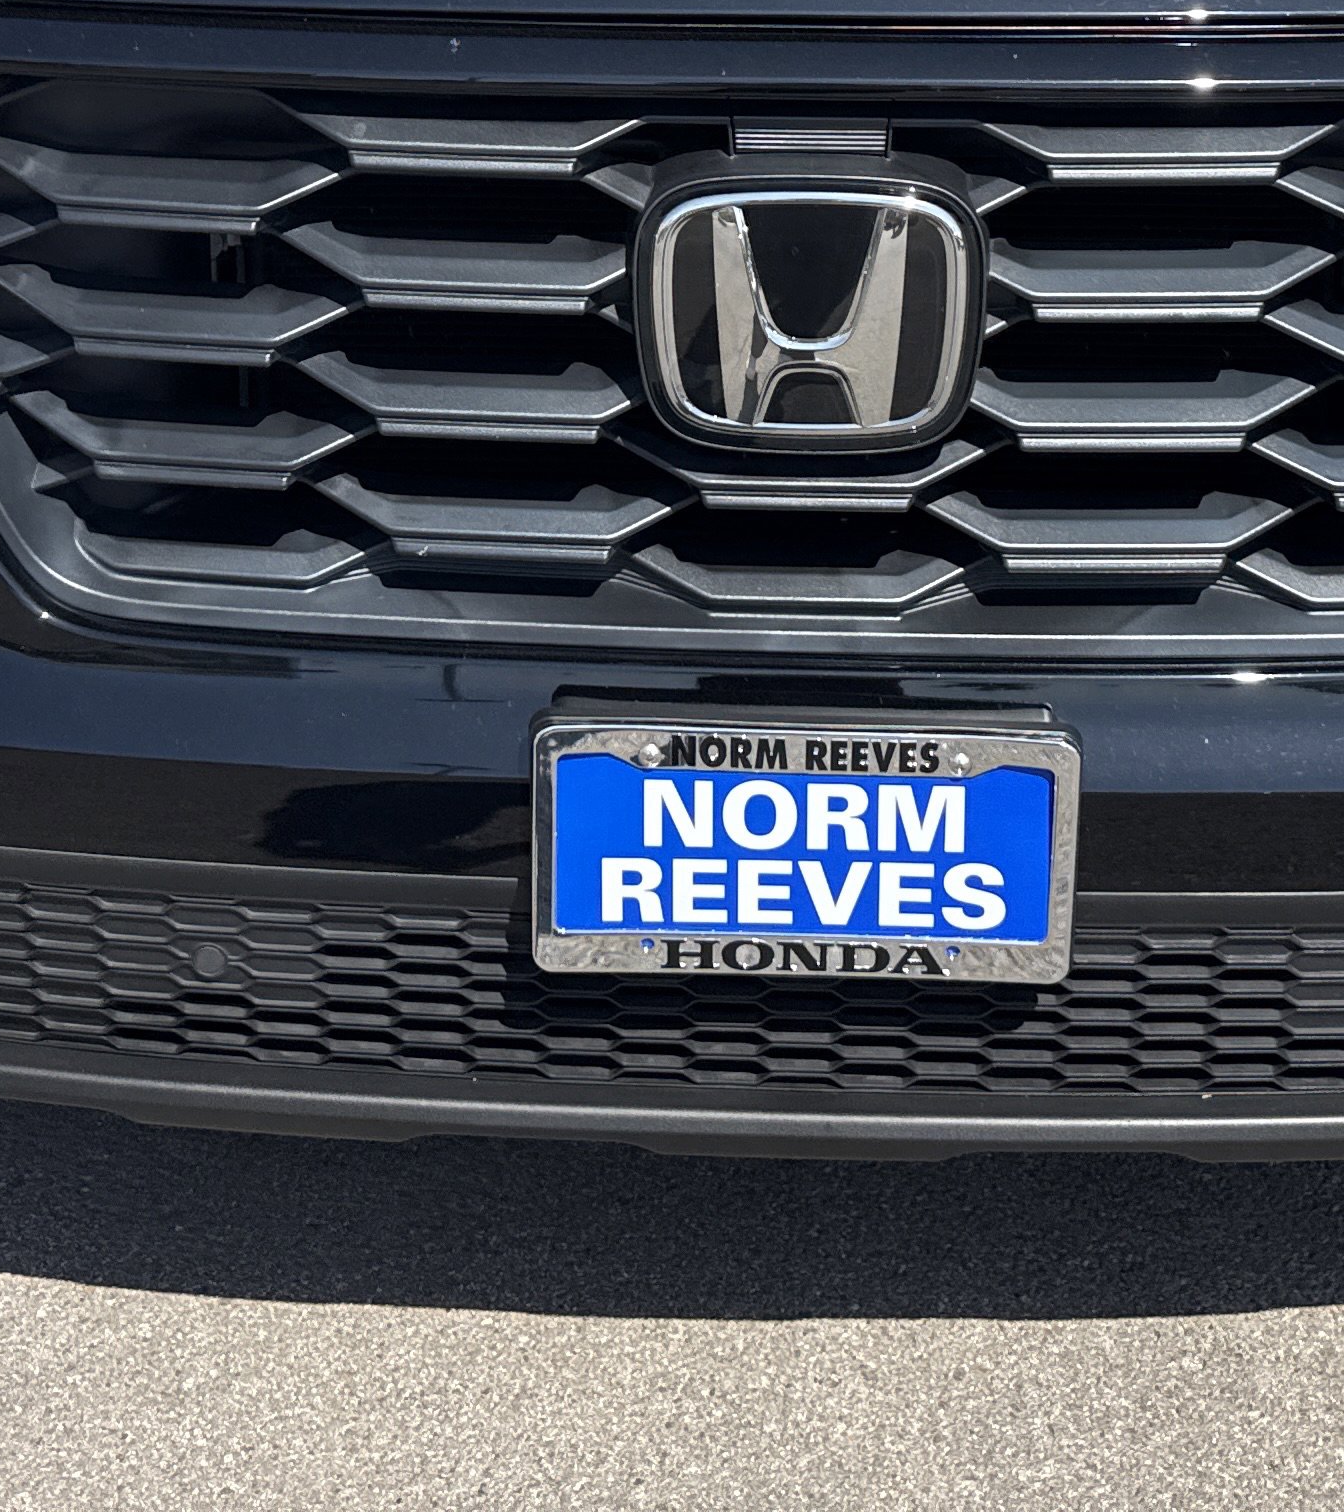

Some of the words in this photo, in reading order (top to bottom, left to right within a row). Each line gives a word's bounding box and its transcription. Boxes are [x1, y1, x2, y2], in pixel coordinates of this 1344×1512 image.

[670, 733, 788, 770] NORM
[804, 737, 941, 774] REEVES
[642, 778, 967, 854] NORM
[600, 857, 1007, 931] REEVES
[660, 938, 949, 976] HONDA
